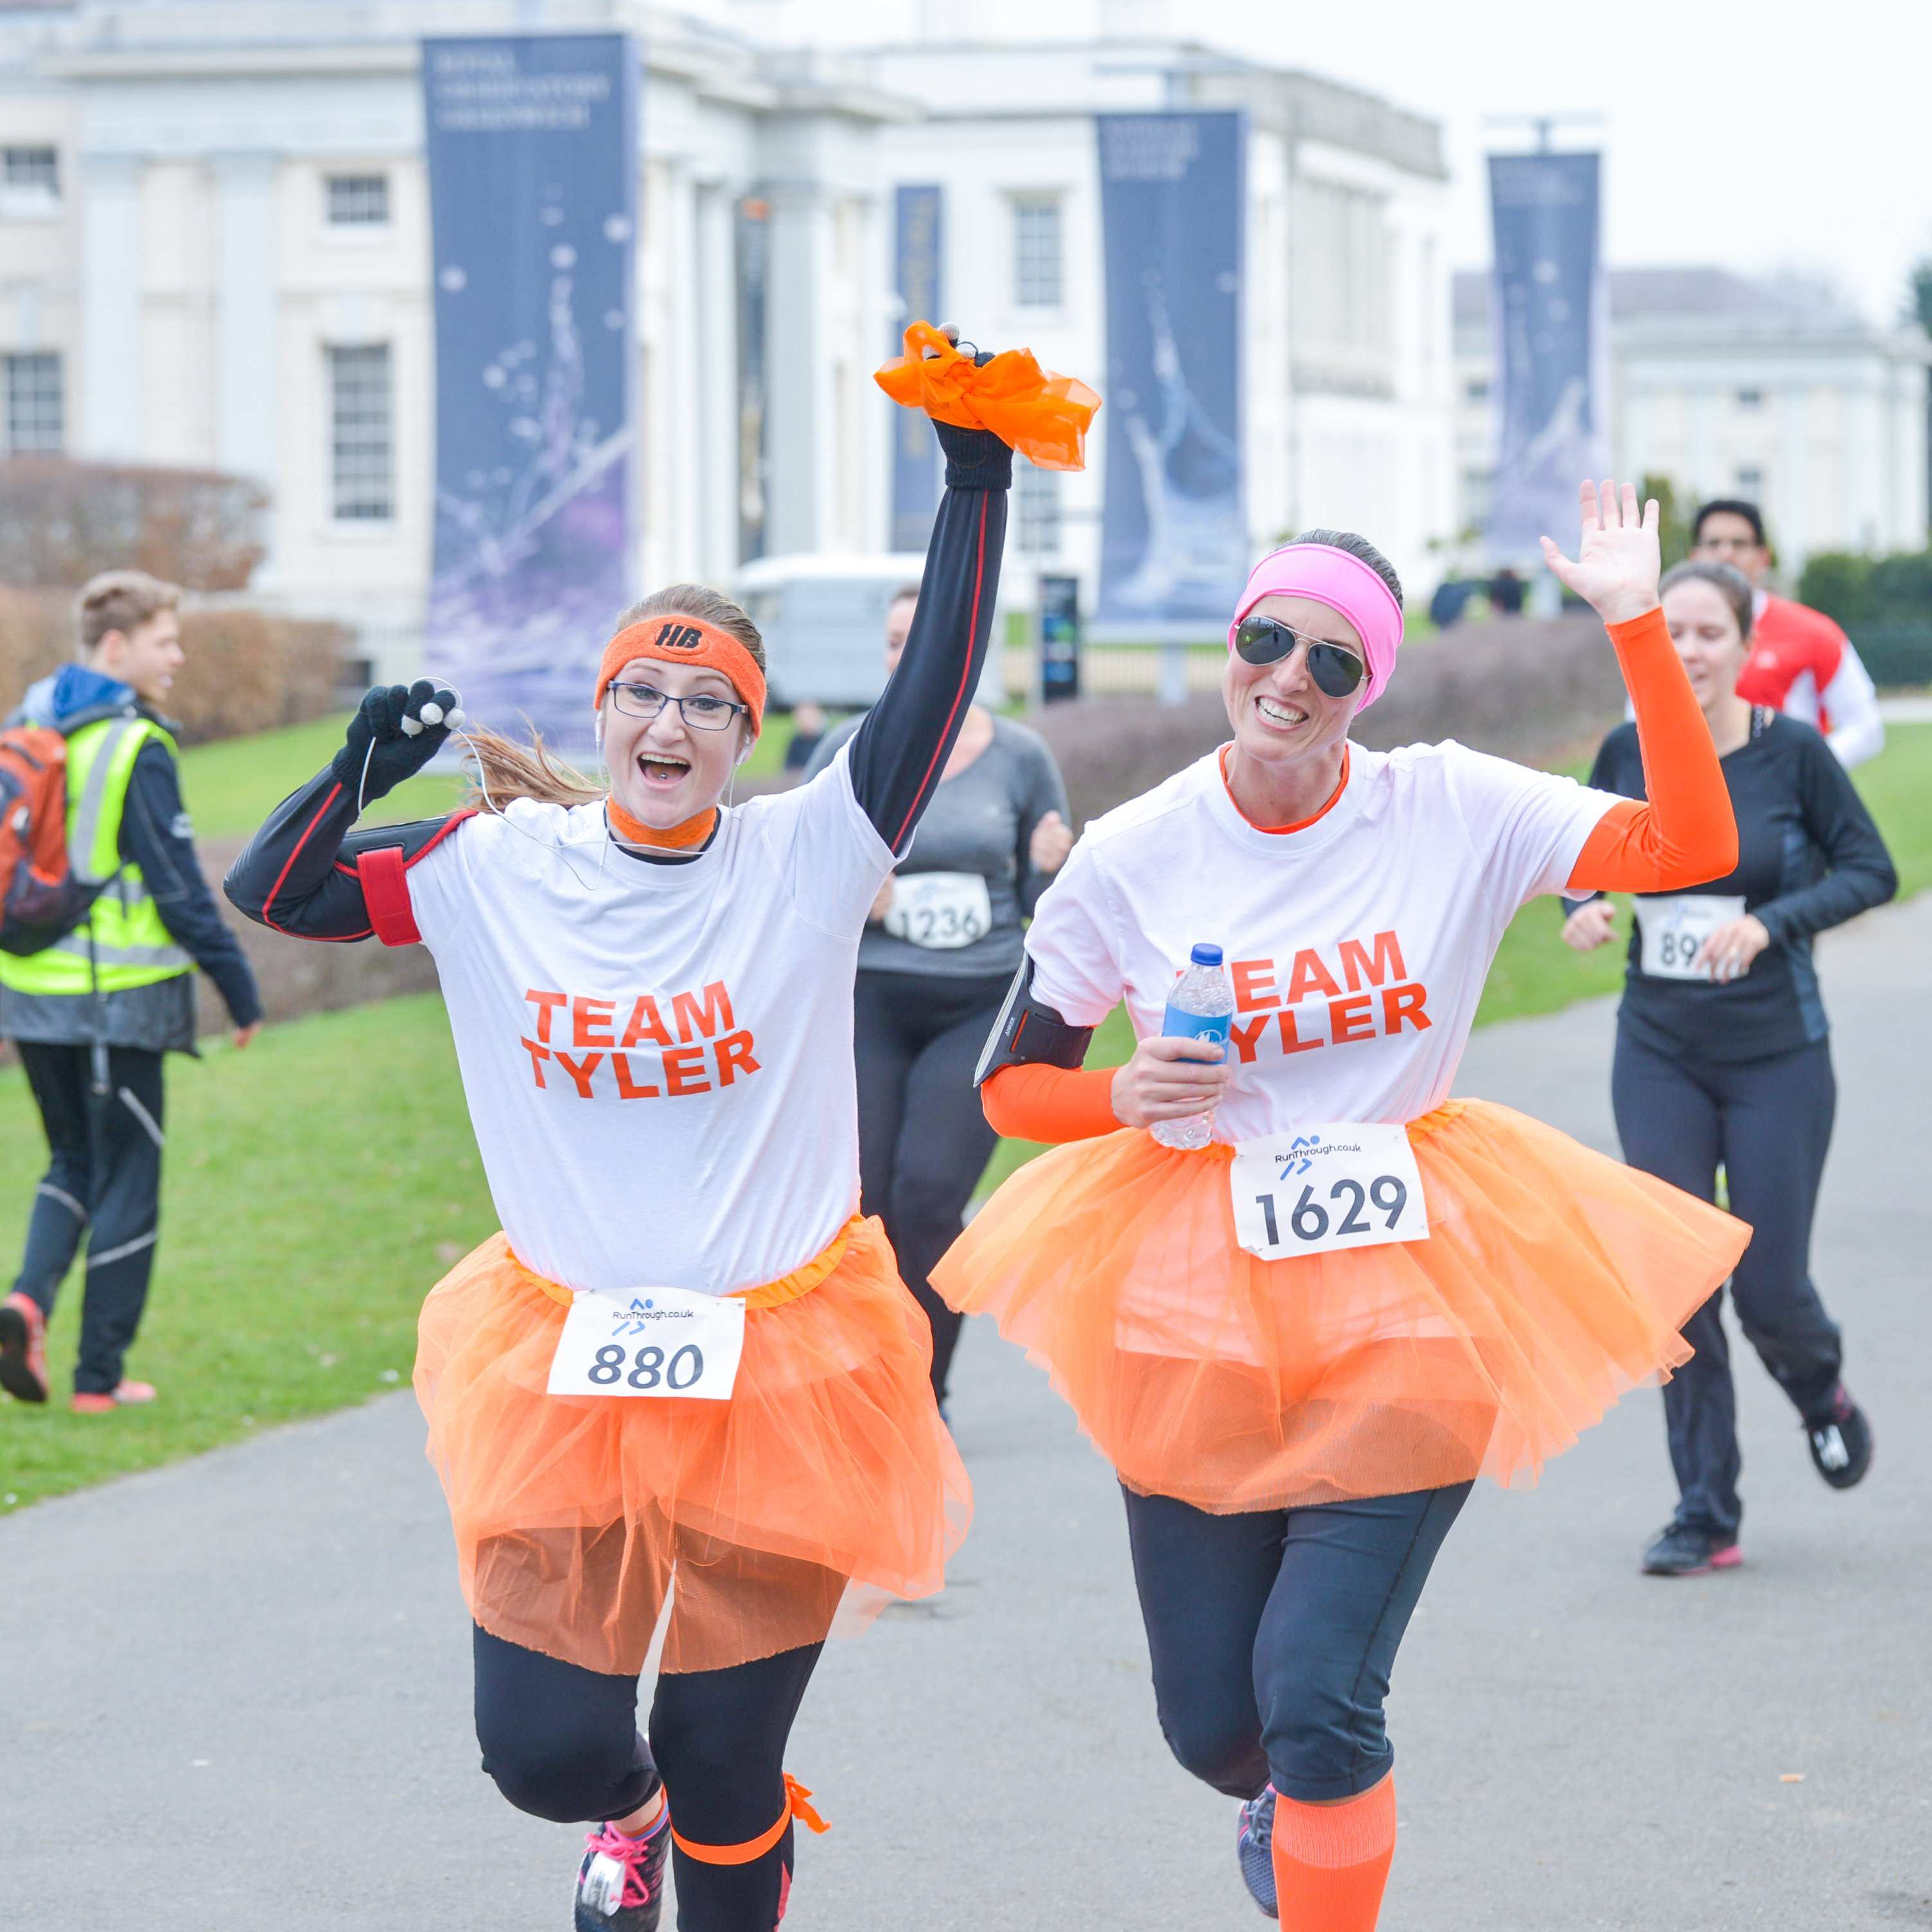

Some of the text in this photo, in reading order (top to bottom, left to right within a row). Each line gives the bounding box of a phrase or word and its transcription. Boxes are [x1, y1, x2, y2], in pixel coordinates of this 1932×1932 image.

[655, 623, 702, 648] HB
[900, 906, 980, 940] 1236
[1176, 930, 1408, 1014] EAM
[1661, 932, 1707, 967] 89
[525, 979, 735, 1048] TEAM
[1229, 983, 1432, 1064] YLER
[521, 1030, 762, 1100] TYLER
[1274, 1143, 1362, 1163] RunThrough.co.uk
[1255, 1175, 1407, 1245] 1629
[612, 1309, 694, 1321] RunThrough.co.uk
[588, 1344, 703, 1389] 880
